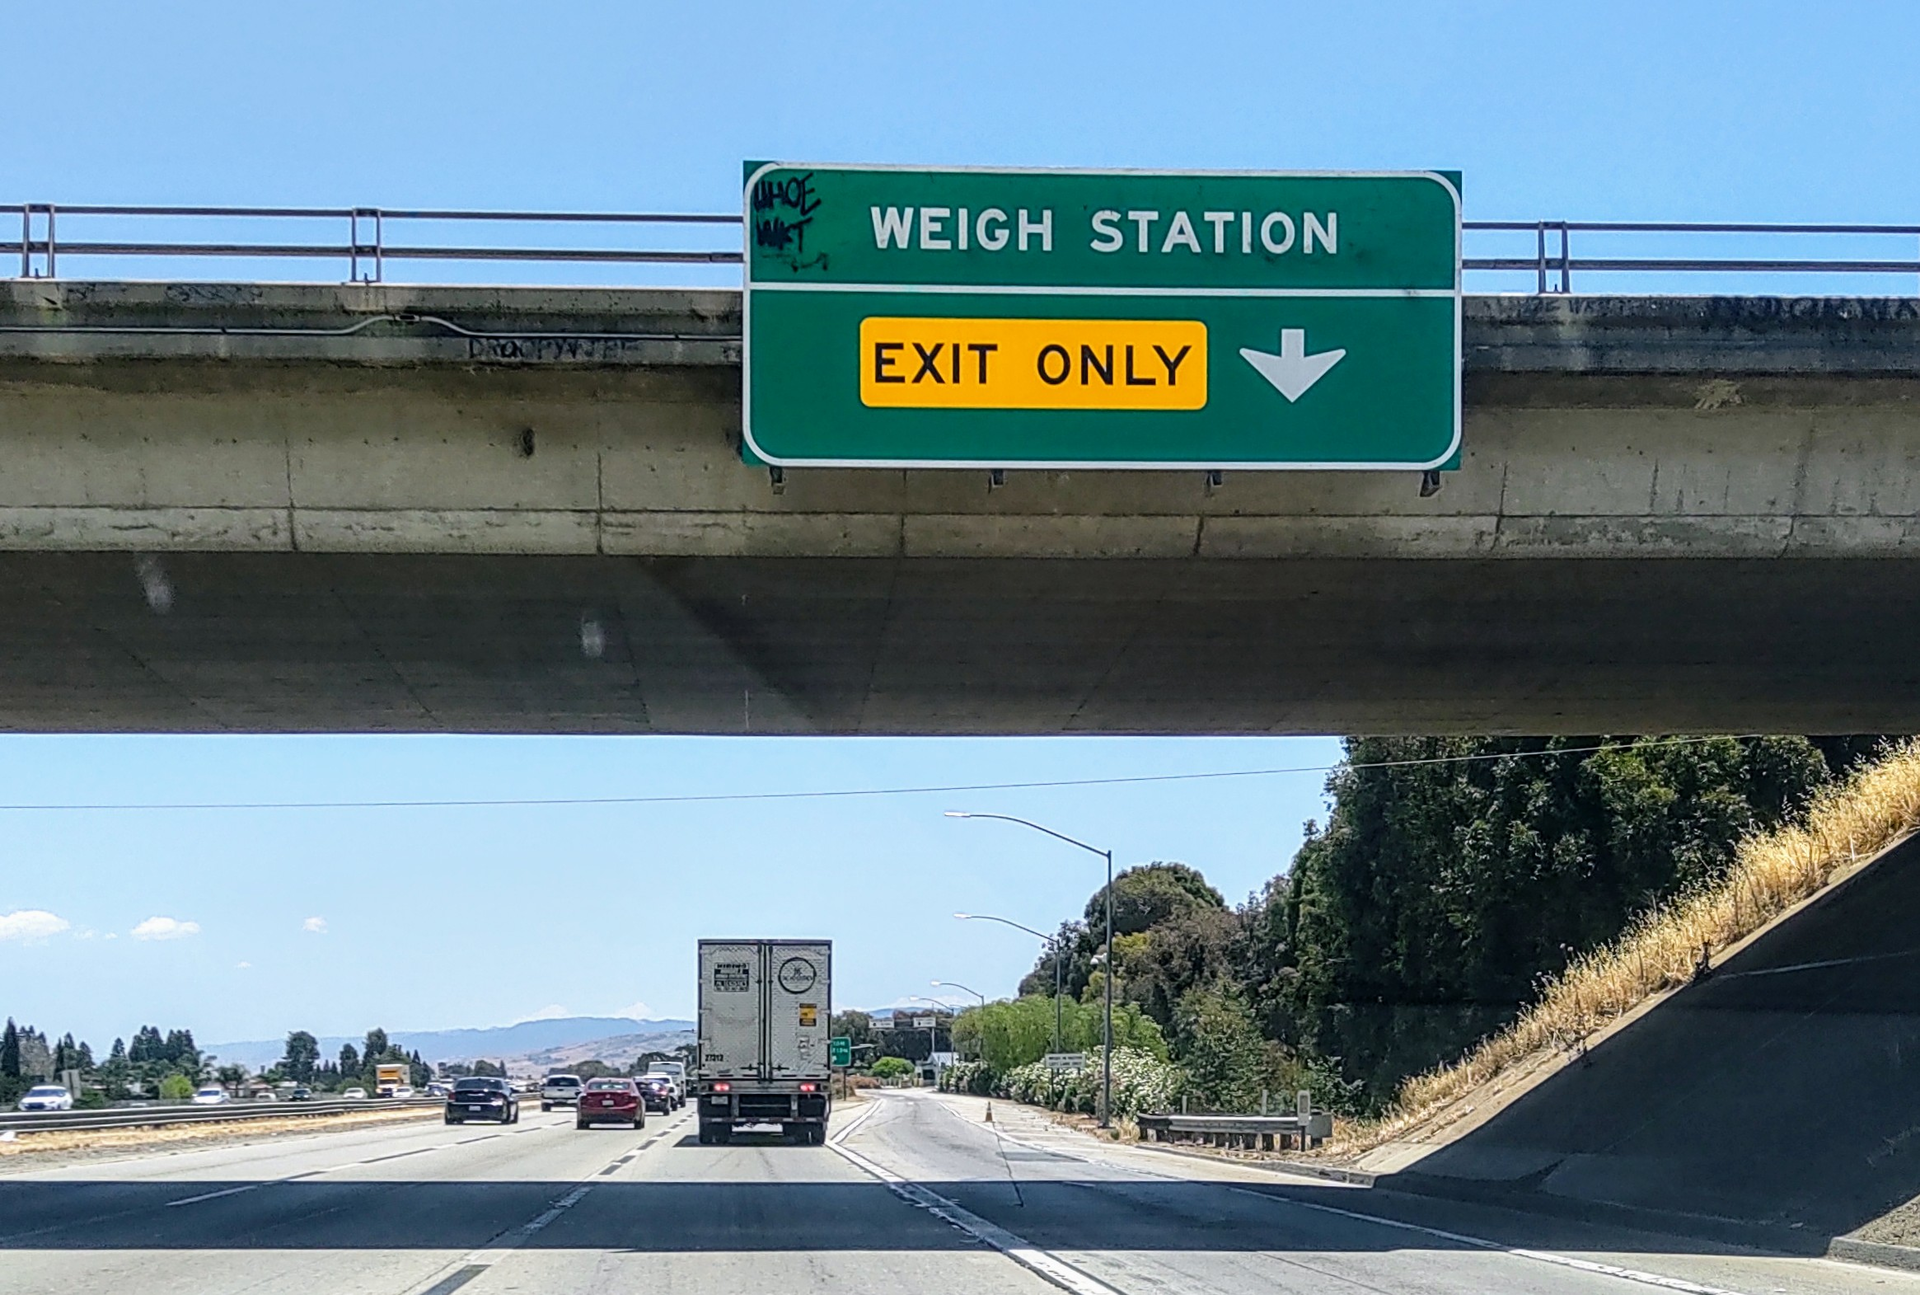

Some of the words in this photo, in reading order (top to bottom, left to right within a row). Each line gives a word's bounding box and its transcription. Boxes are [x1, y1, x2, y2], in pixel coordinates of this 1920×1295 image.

[870, 206, 1053, 252] WEIGH
[1090, 210, 1338, 255] STATION
[874, 342, 998, 384] EXIT
[1037, 344, 1192, 387] ONLY
